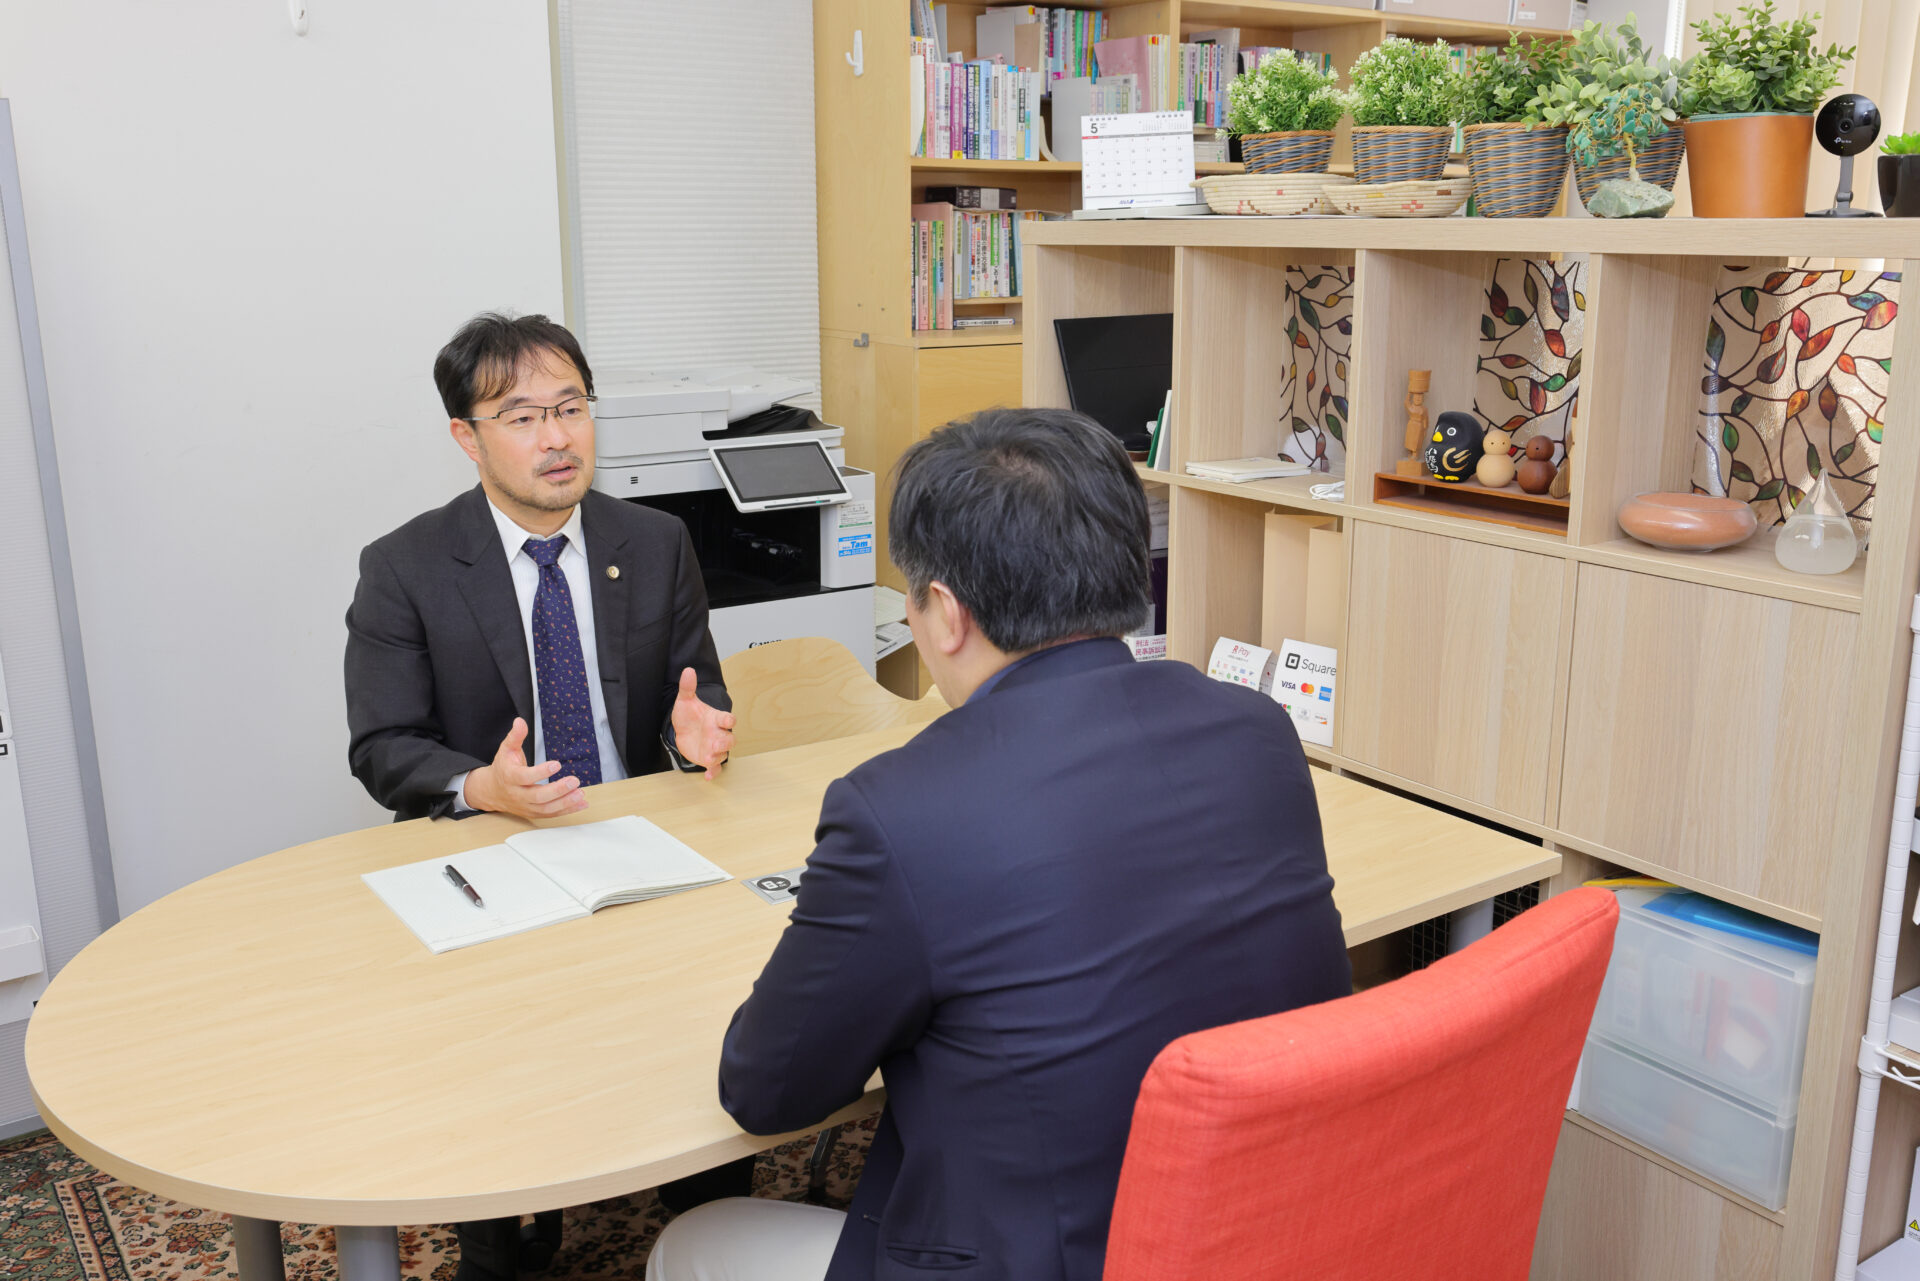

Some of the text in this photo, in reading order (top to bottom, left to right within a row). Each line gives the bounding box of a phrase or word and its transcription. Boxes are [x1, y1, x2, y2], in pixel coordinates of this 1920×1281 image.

[1090, 123, 1098, 134] 5
[1302, 658, 1336, 676] Square
[1282, 680, 1296, 690] VISA
